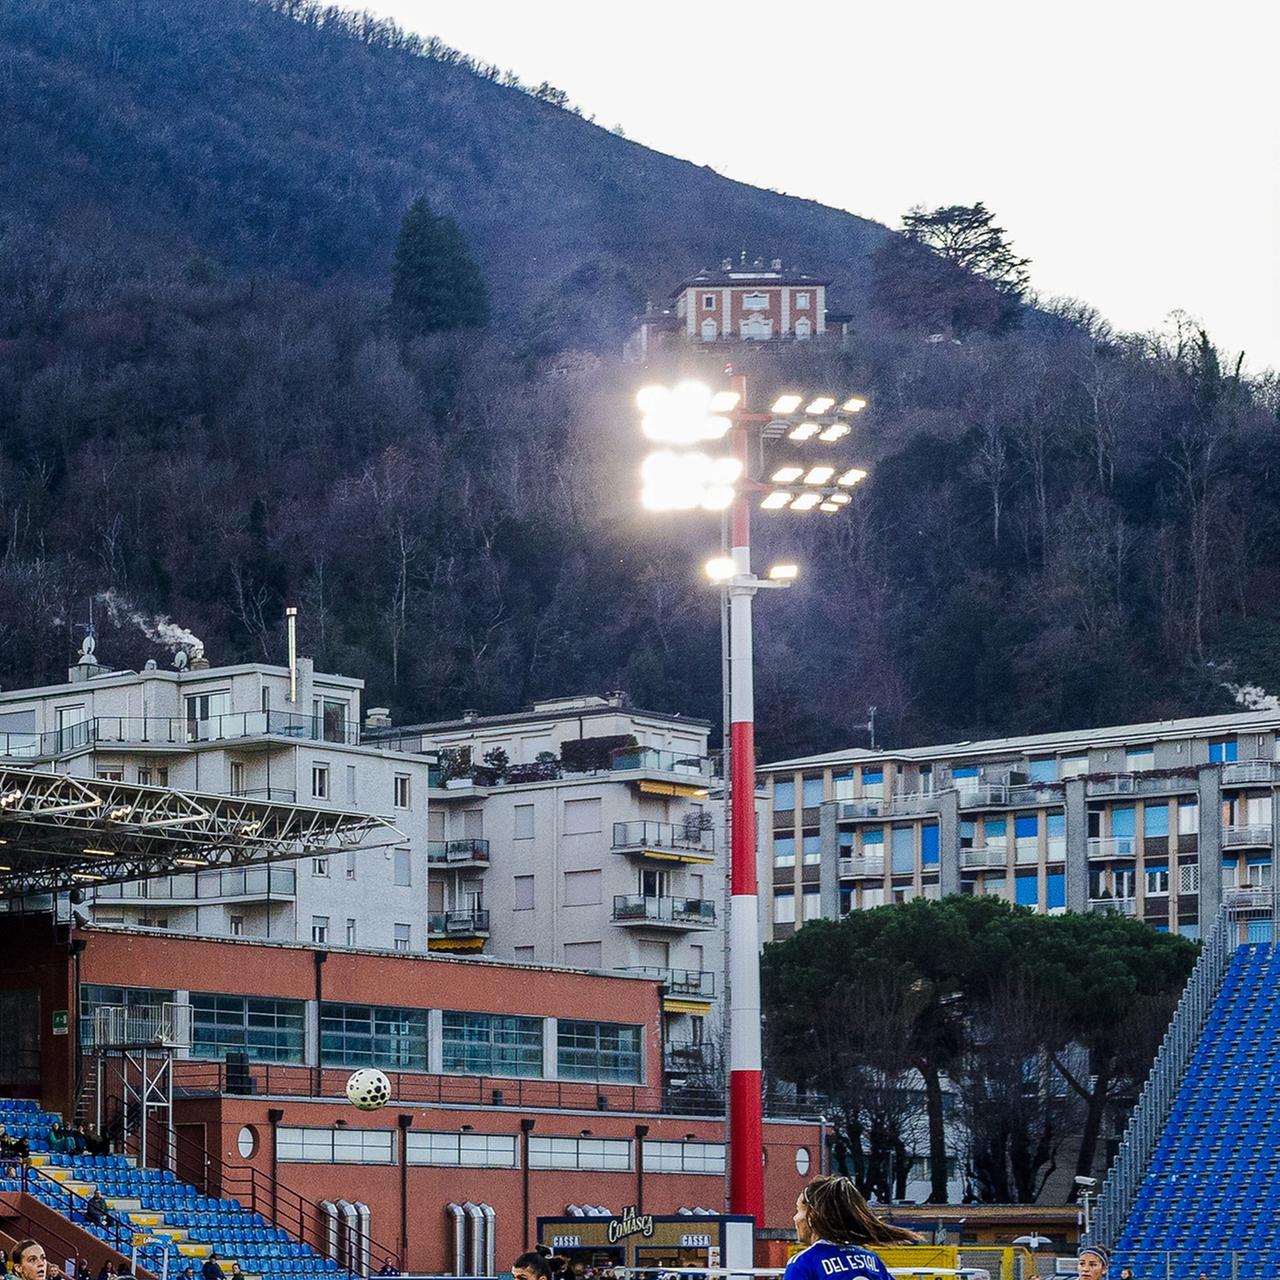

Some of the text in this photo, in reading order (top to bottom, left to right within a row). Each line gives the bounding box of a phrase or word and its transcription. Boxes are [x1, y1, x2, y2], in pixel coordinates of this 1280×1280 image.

[623, 1206, 636, 1220] LA
[554, 1236, 580, 1247] CASSA
[682, 1236, 709, 1246] CASSA
[822, 1257, 848, 1275] DEL
